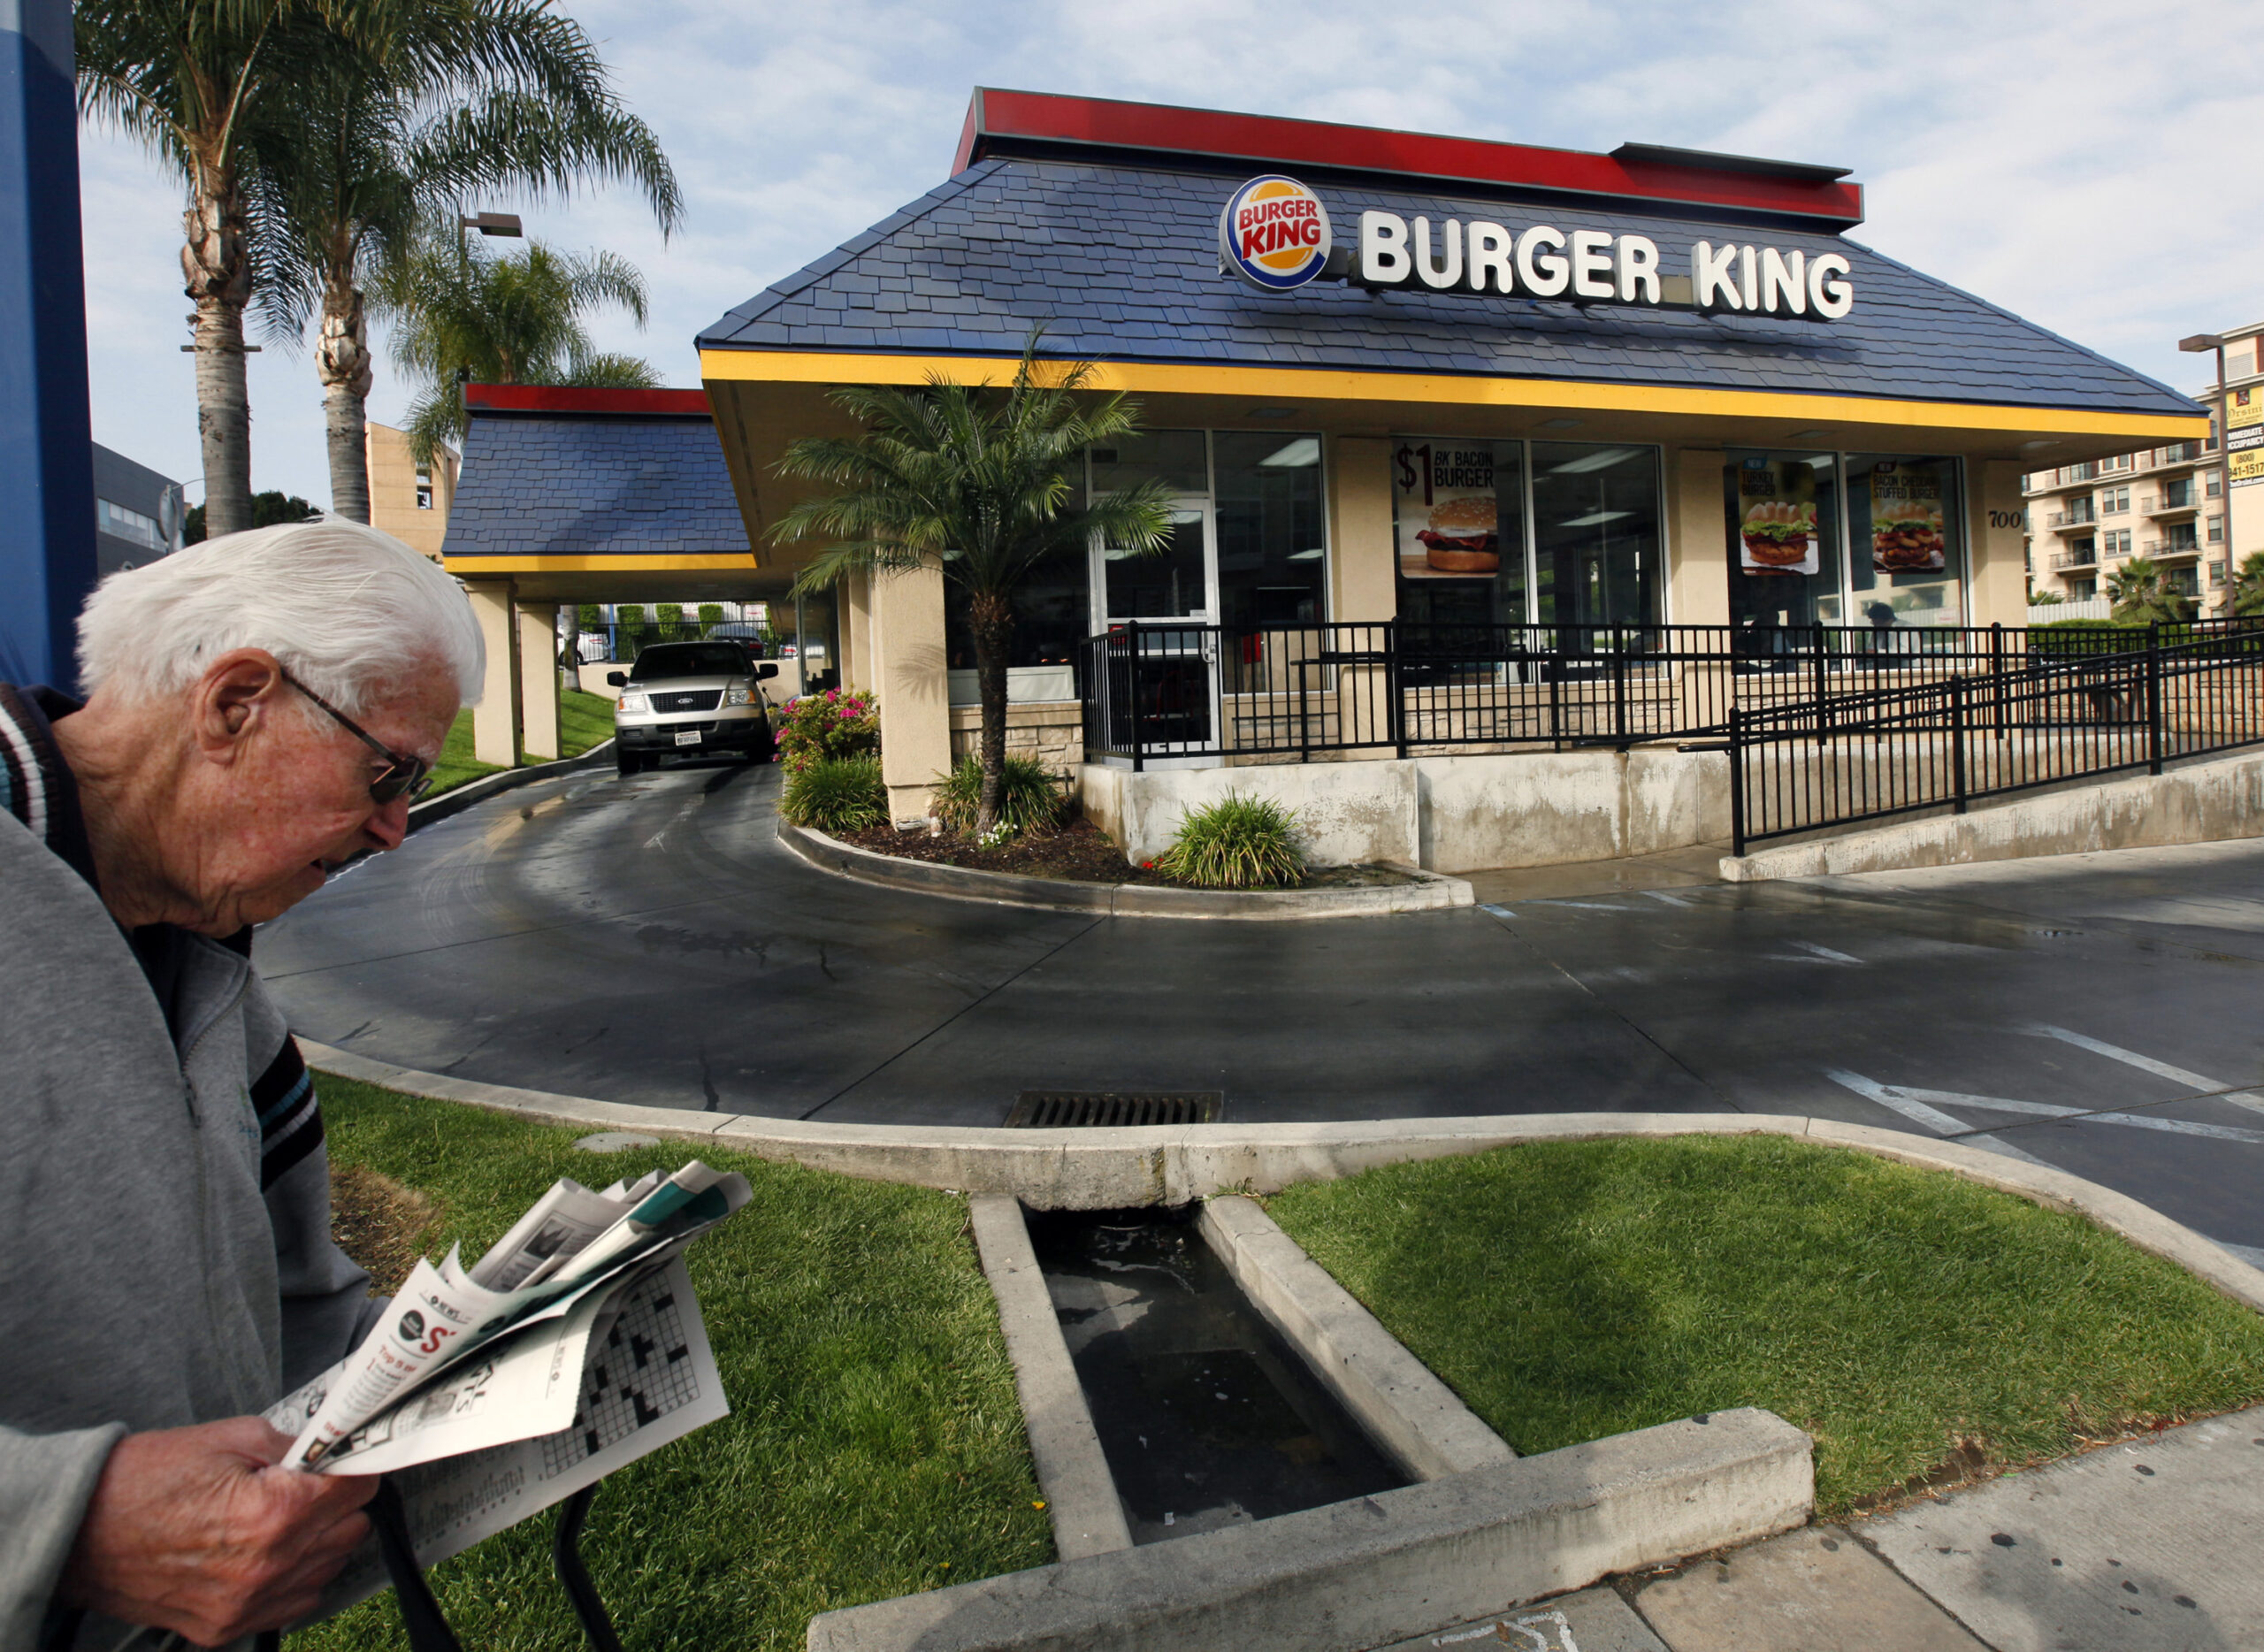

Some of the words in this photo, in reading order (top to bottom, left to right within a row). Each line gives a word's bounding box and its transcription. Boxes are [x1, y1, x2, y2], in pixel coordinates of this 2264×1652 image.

[1239, 200, 1318, 231] BURGER
[1242, 218, 1321, 260] KING
[1359, 210, 1661, 304] BURGER
[1692, 241, 1855, 319] KING
[1434, 451, 1450, 466] BK
[1455, 451, 1494, 467] BACON
[2236, 453, 2254, 464] (800)
[1396, 443, 1434, 506] $1
[1434, 468, 1494, 487] BURGER
[1873, 486, 1907, 499] STUFFED
[1988, 509, 2022, 529] 700
